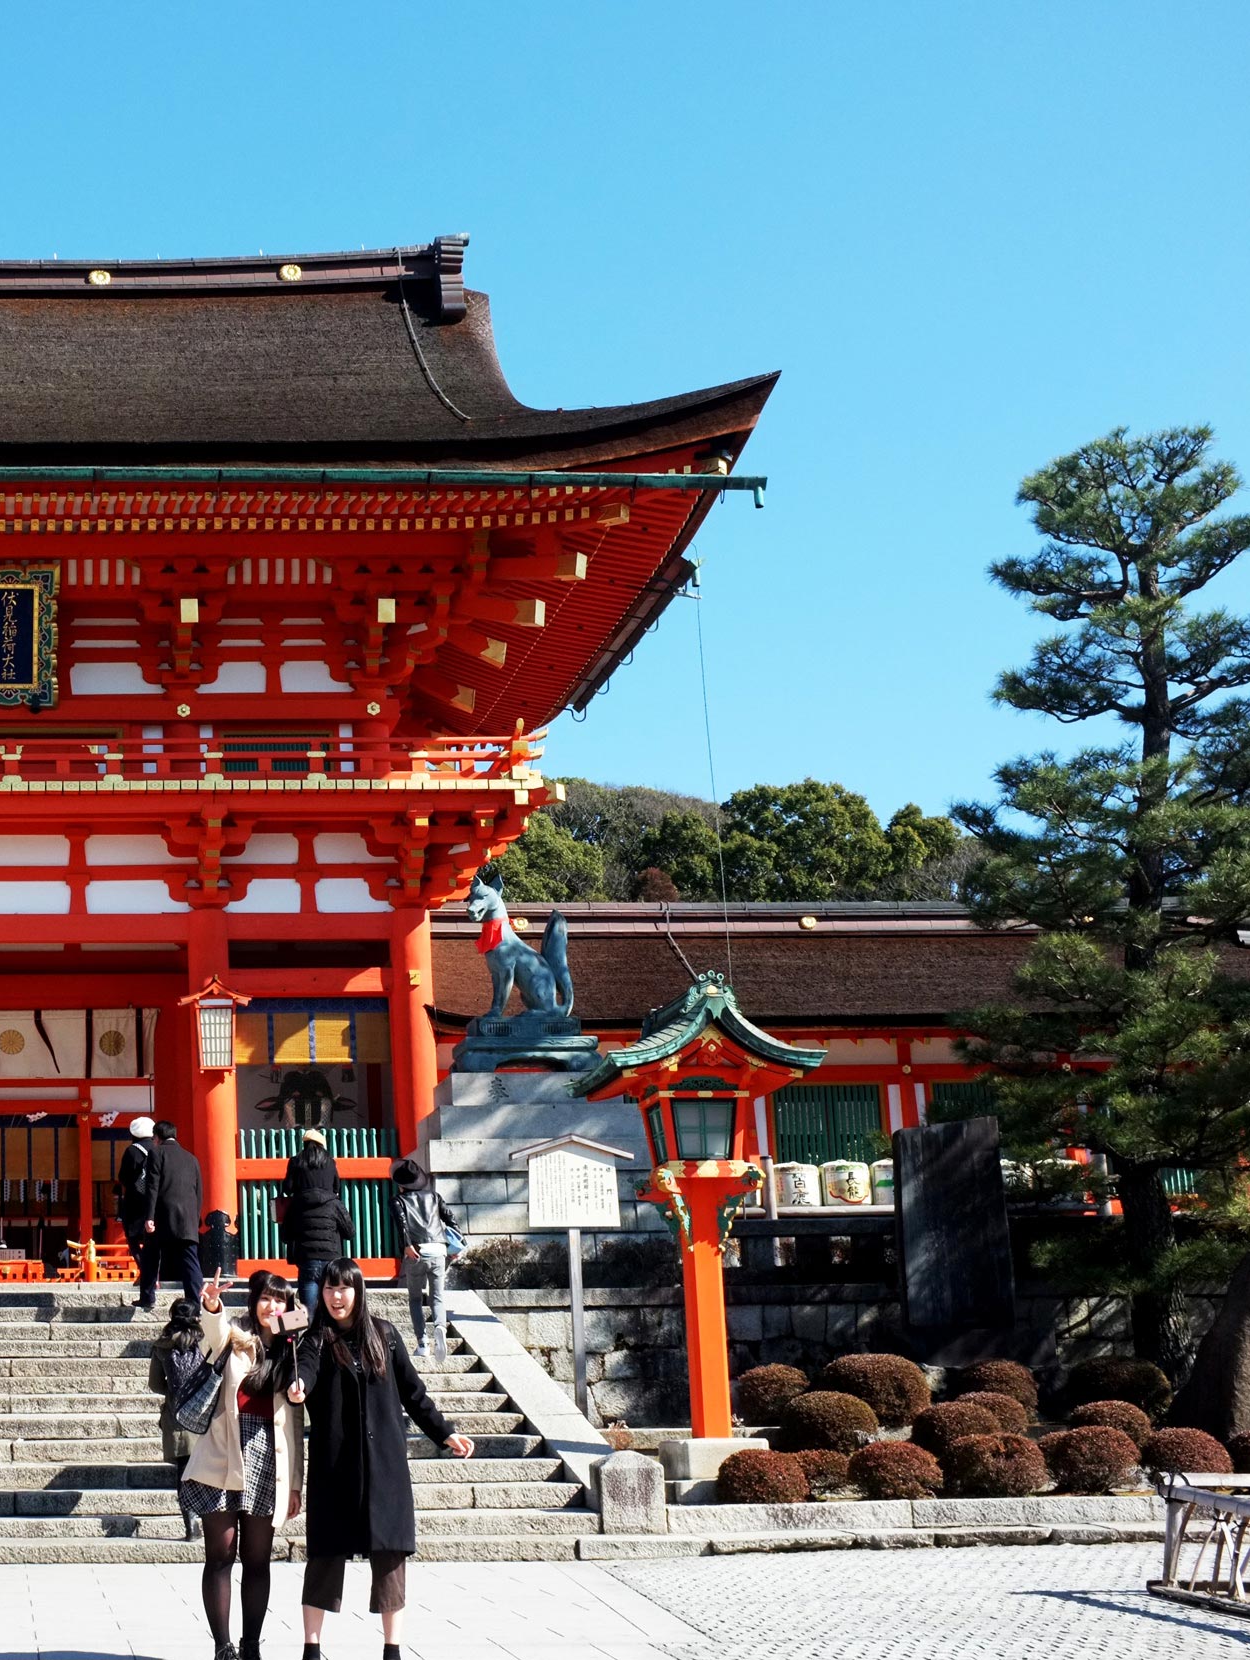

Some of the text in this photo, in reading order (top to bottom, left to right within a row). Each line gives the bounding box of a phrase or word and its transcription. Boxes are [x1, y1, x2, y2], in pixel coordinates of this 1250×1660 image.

[1, 591, 19, 680] 伏見稲荷大社
